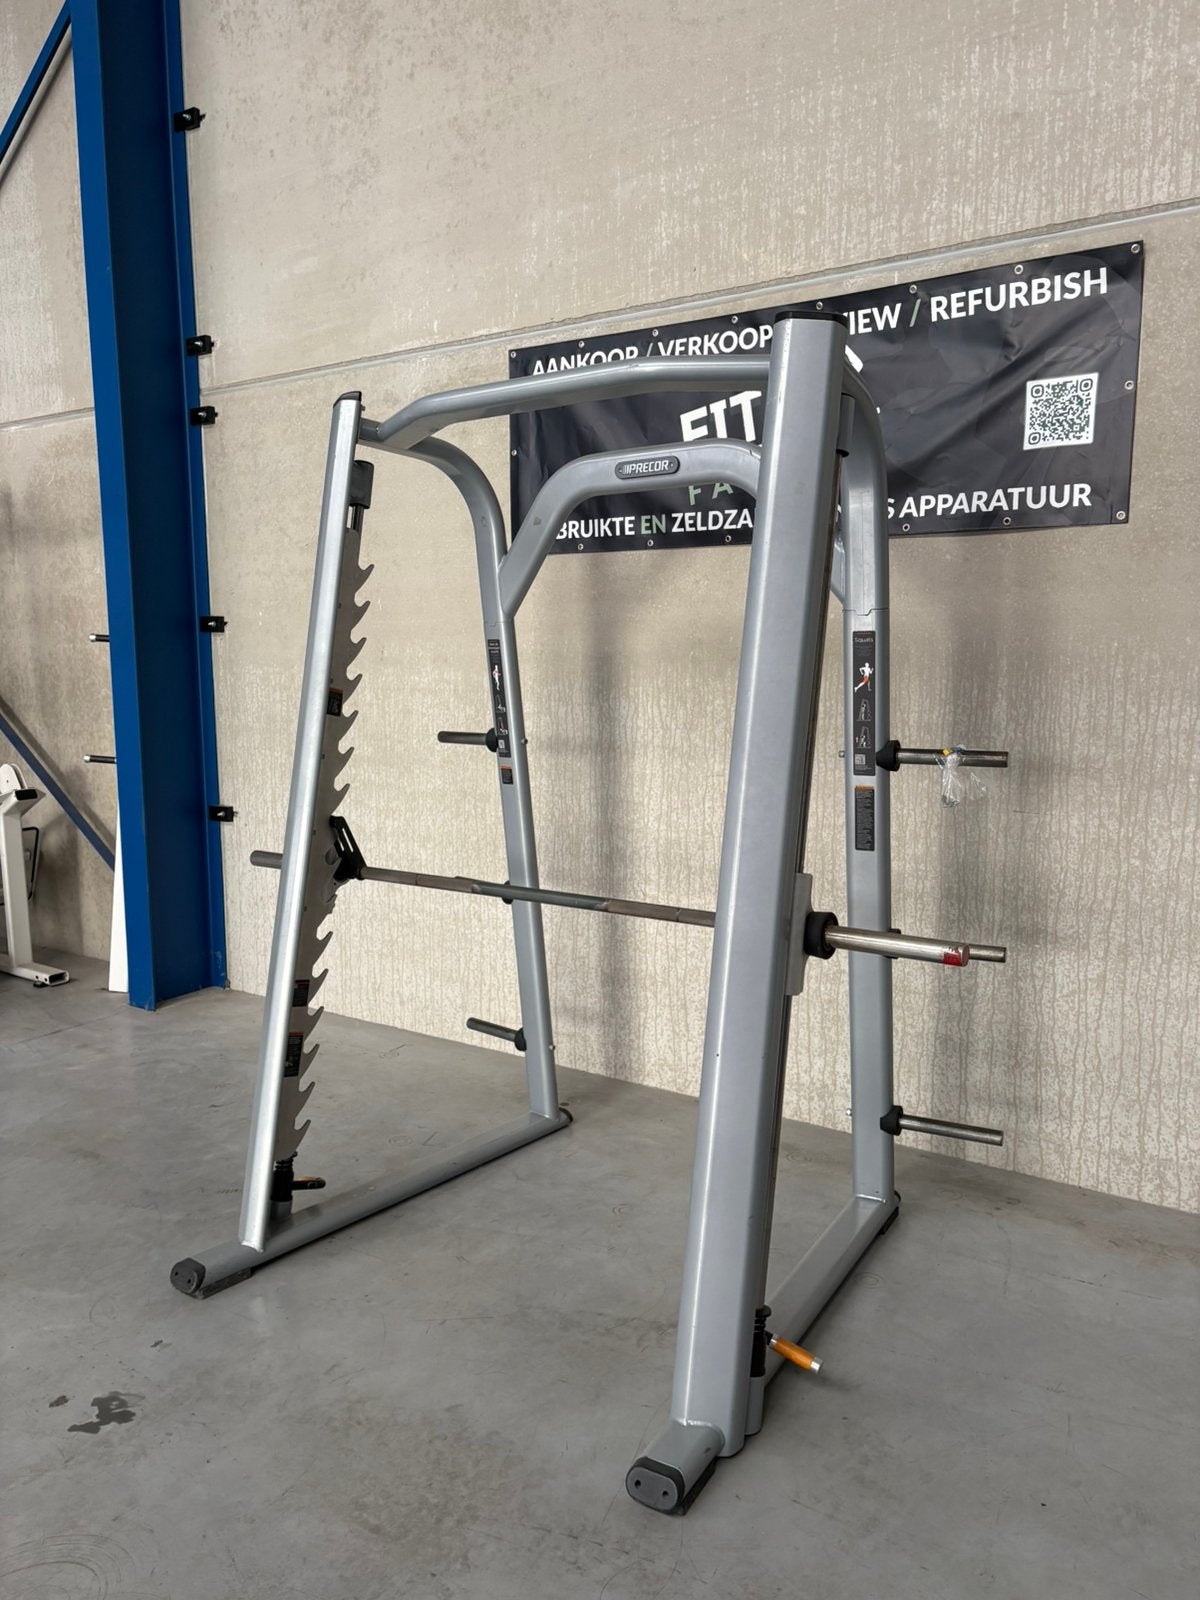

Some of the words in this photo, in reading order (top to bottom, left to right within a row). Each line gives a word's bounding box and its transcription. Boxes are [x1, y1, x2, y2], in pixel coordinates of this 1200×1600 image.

[533, 346, 639, 376] AANKOOP
[657, 324, 774, 356] VERKOOP
[842, 302, 902, 336] IEW
[909, 298, 922, 328] /
[930, 267, 1107, 322] REFURBISH
[628, 460, 669, 475] PRECOR
[640, 514, 667, 535] EN
[899, 483, 1092, 518] APPARATUUR
